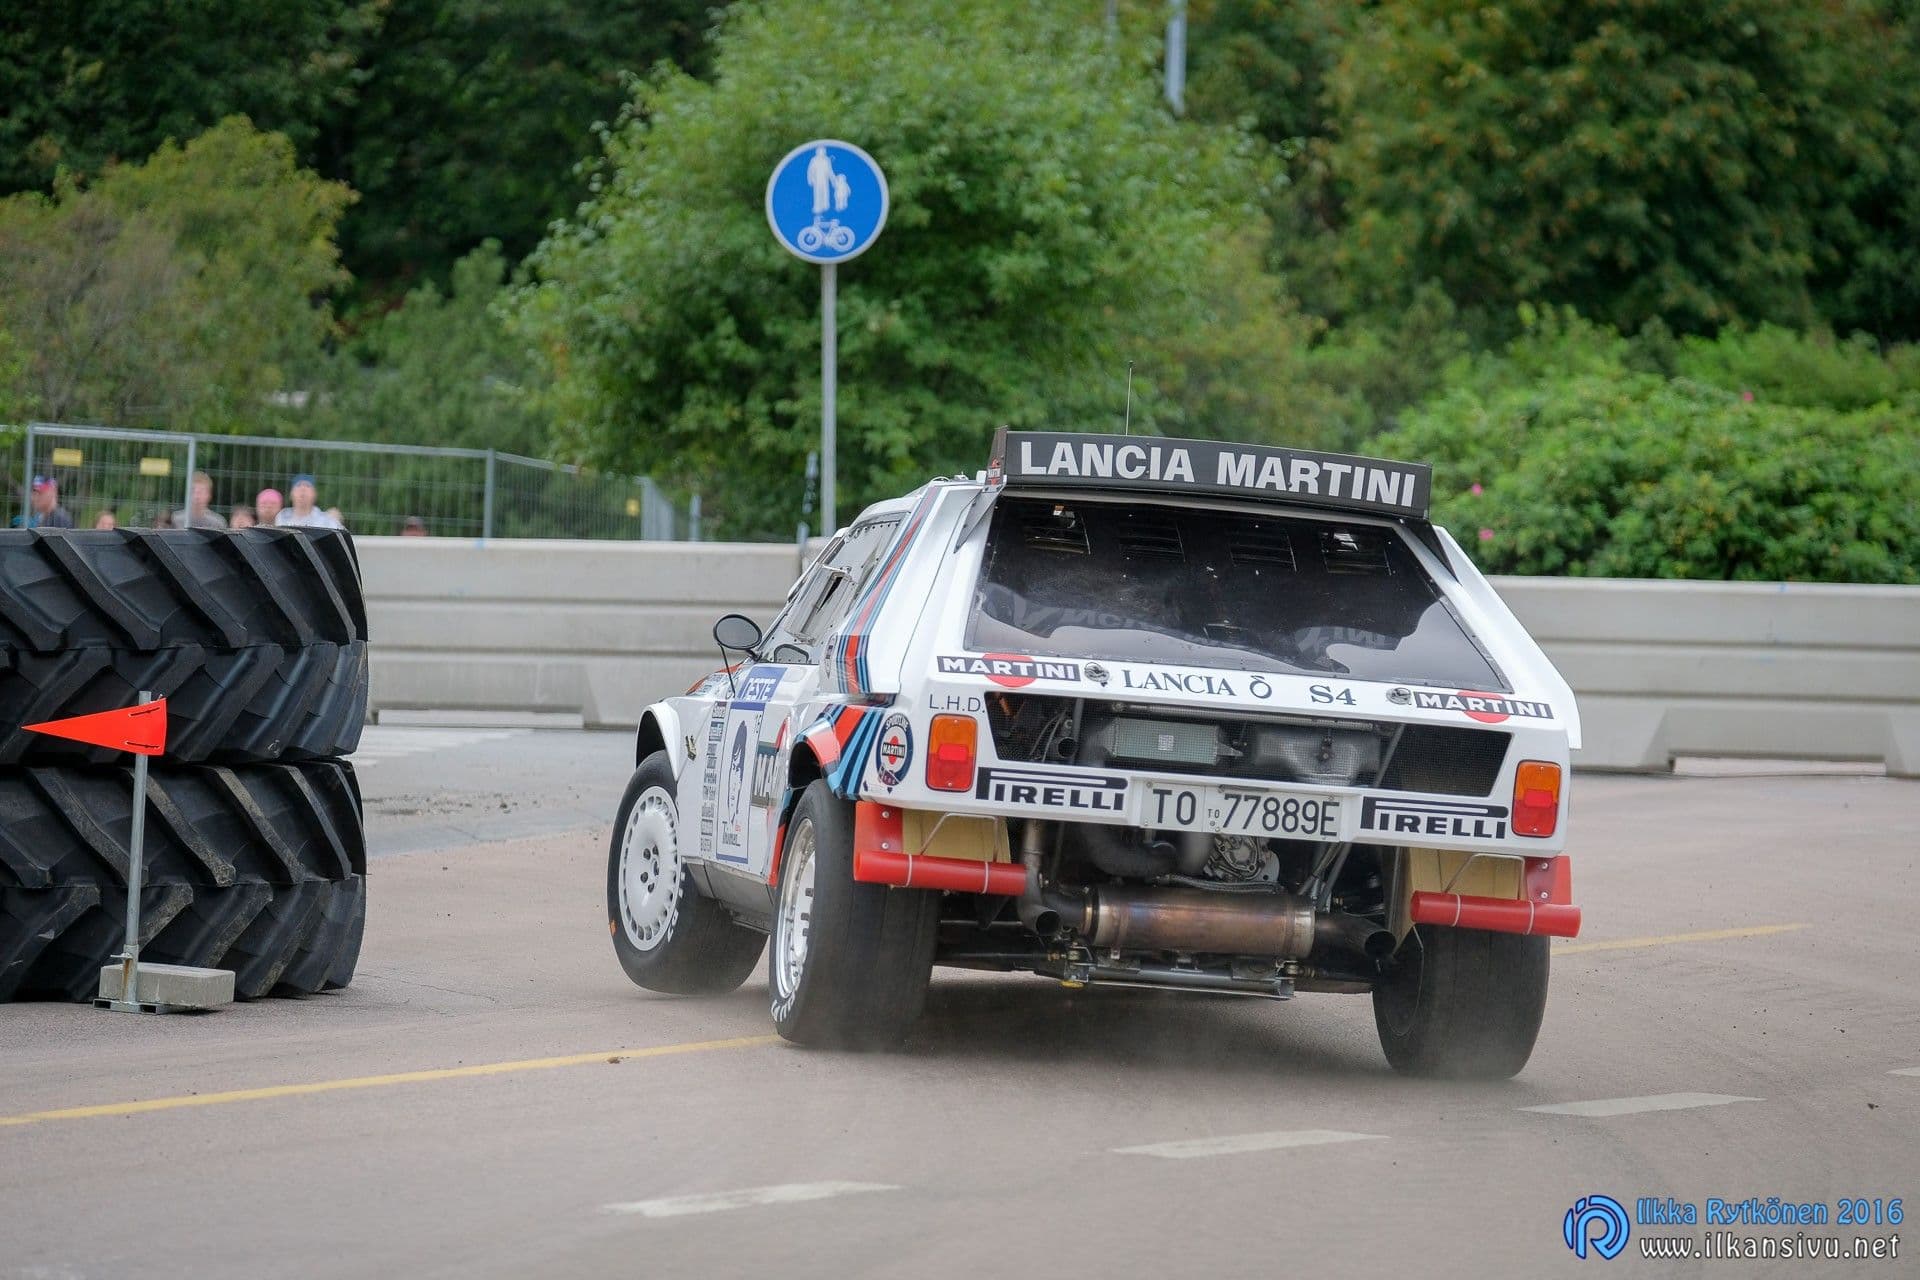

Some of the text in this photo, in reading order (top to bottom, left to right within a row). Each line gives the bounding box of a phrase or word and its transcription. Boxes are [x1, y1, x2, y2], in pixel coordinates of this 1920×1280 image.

[1020, 441, 1416, 507] LANCIA MARTINI
[943, 658, 1075, 680] MARTINI
[1122, 669, 1236, 696] LANCIA
[1309, 684, 1357, 704] S4
[929, 693, 985, 713] L.H.D.
[1418, 692, 1550, 716] MARTINI
[976, 767, 1128, 810] PIRELLI
[1152, 788, 1197, 826] TO
[1223, 793, 1340, 836] 77889E
[1360, 796, 1508, 839] PIRELLI
